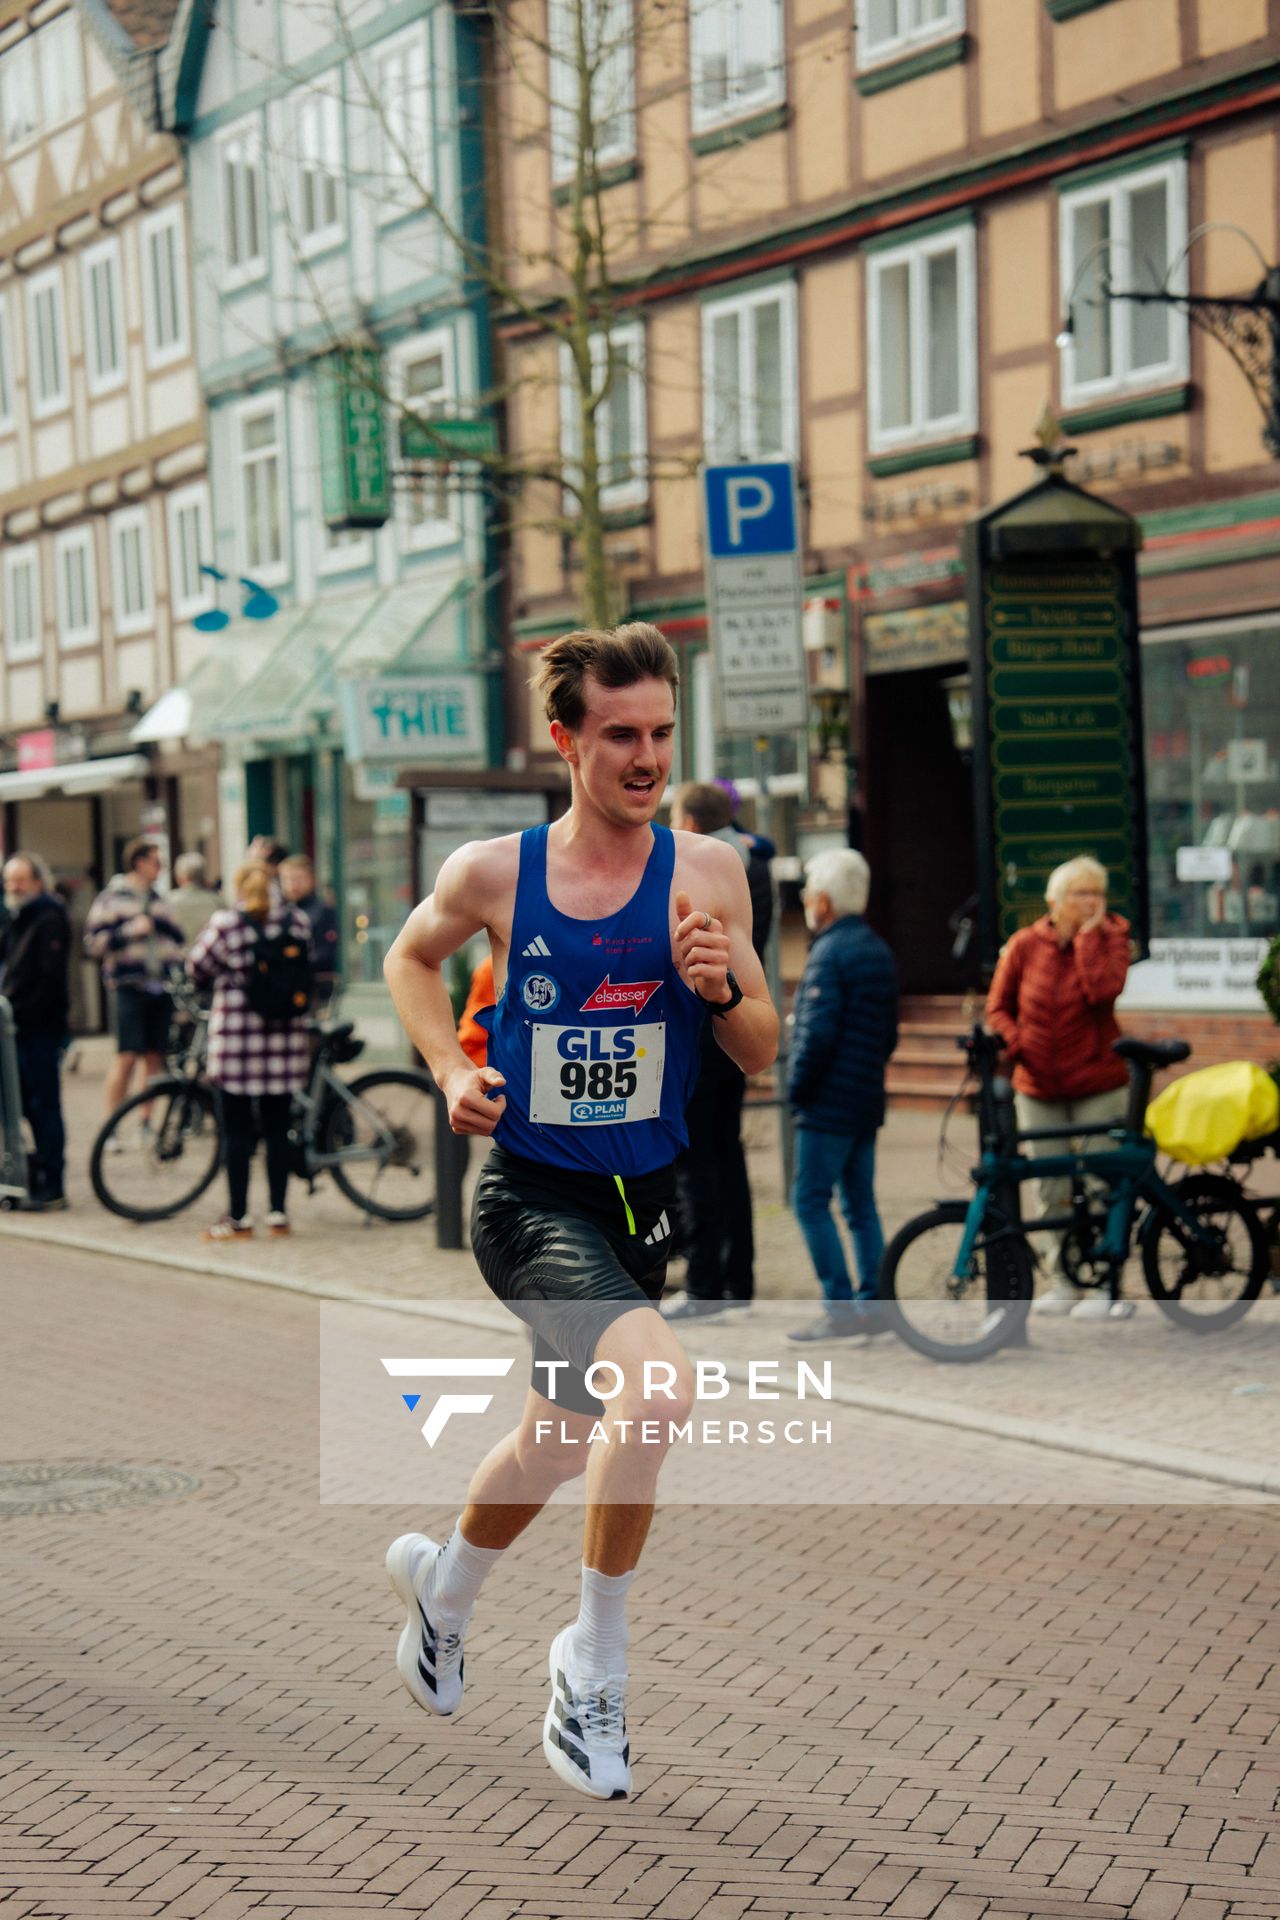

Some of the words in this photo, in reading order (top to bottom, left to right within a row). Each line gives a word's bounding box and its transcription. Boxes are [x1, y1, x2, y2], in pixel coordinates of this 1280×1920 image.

[726, 476, 775, 546] P
[595, 988, 647, 1003] elsässer
[560, 1061, 637, 1100] 985
[594, 1103, 625, 1114] PLAN
